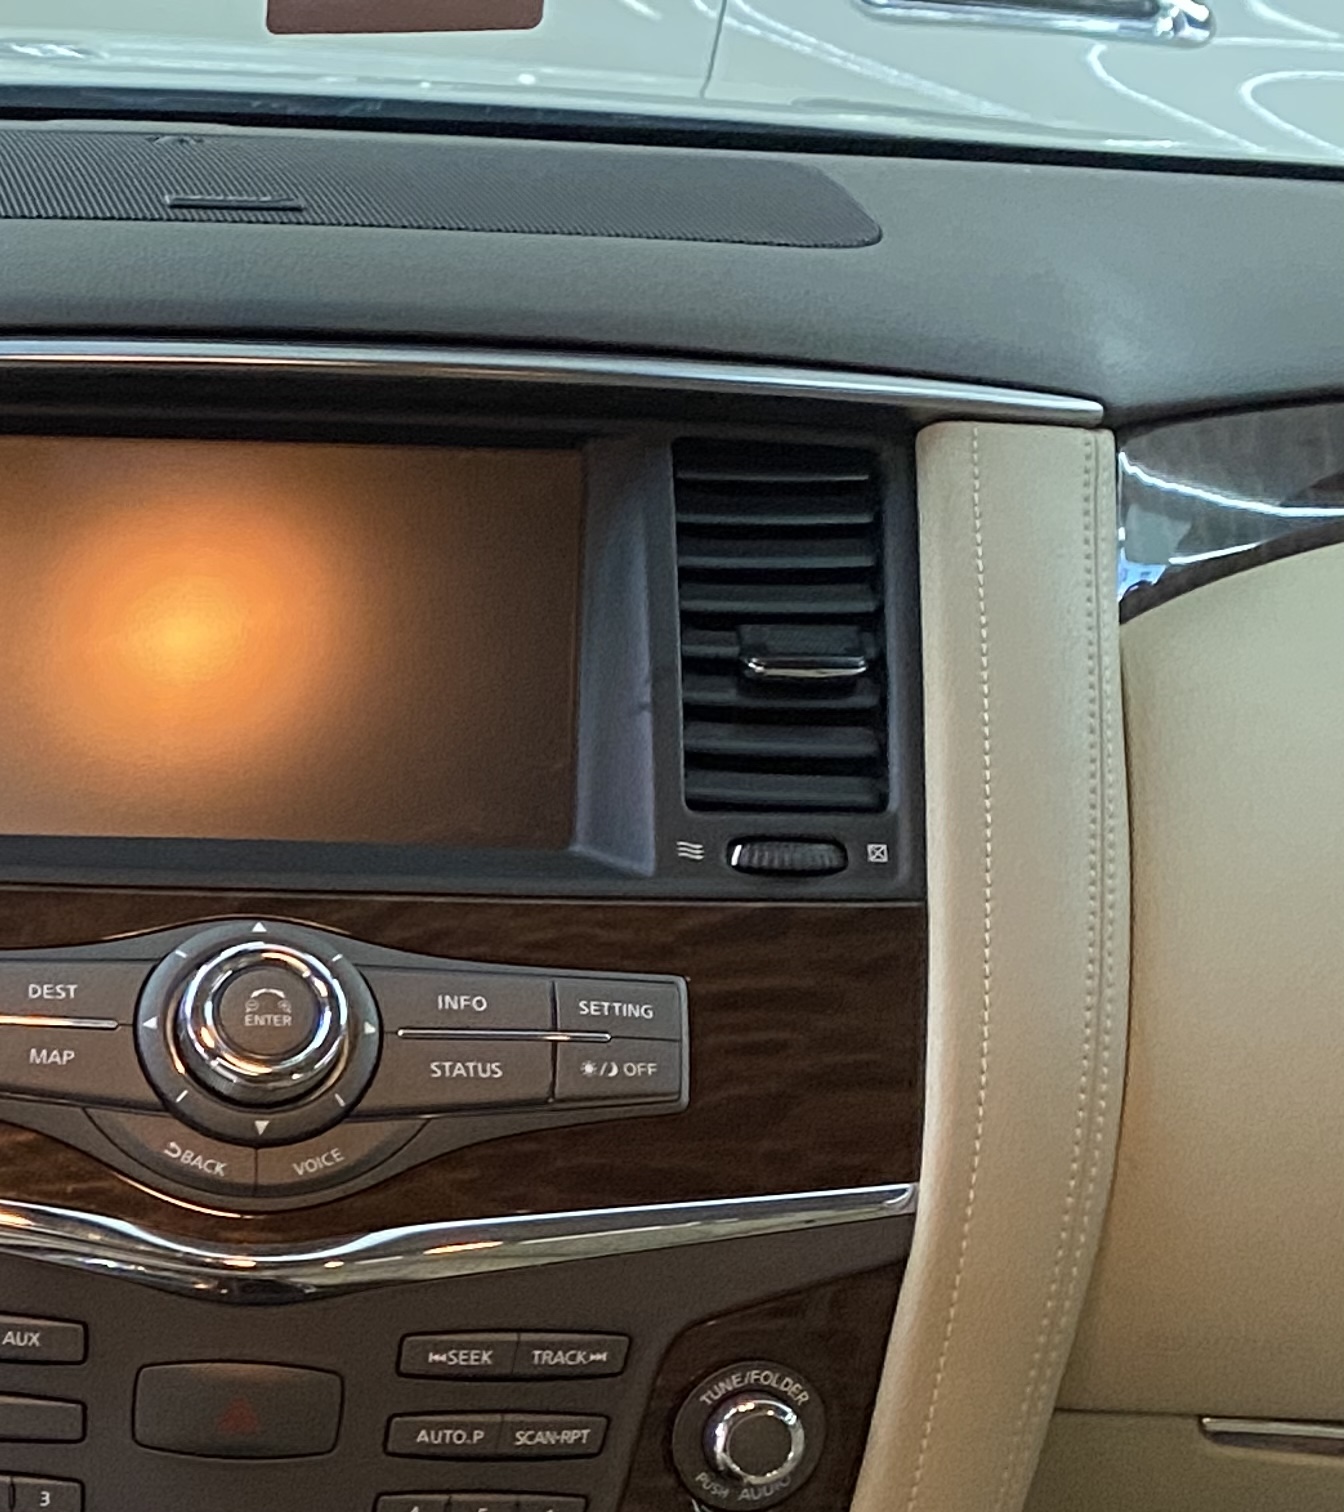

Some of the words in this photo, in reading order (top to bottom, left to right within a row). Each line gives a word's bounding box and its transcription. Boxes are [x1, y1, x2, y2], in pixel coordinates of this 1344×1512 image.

[28, 984, 78, 999] DEST
[438, 994, 487, 1012] INFO
[579, 1000, 654, 1020] SETTING
[244, 1014, 292, 1027] ENTER
[29, 1048, 75, 1066] MAP
[429, 1061, 503, 1079] STATUS
[623, 1062, 657, 1077] OFF
[181, 1148, 227, 1177] BACK
[292, 1147, 345, 1177] VOICE
[2, 1331, 41, 1347] AUX
[447, 1349, 493, 1366] SEEK
[532, 1349, 588, 1366] TRACK
[700, 1371, 810, 1406] TUNE/FOLDER
[695, 1472, 730, 1498] PUSH
[40, 1491, 51, 1507] 3
